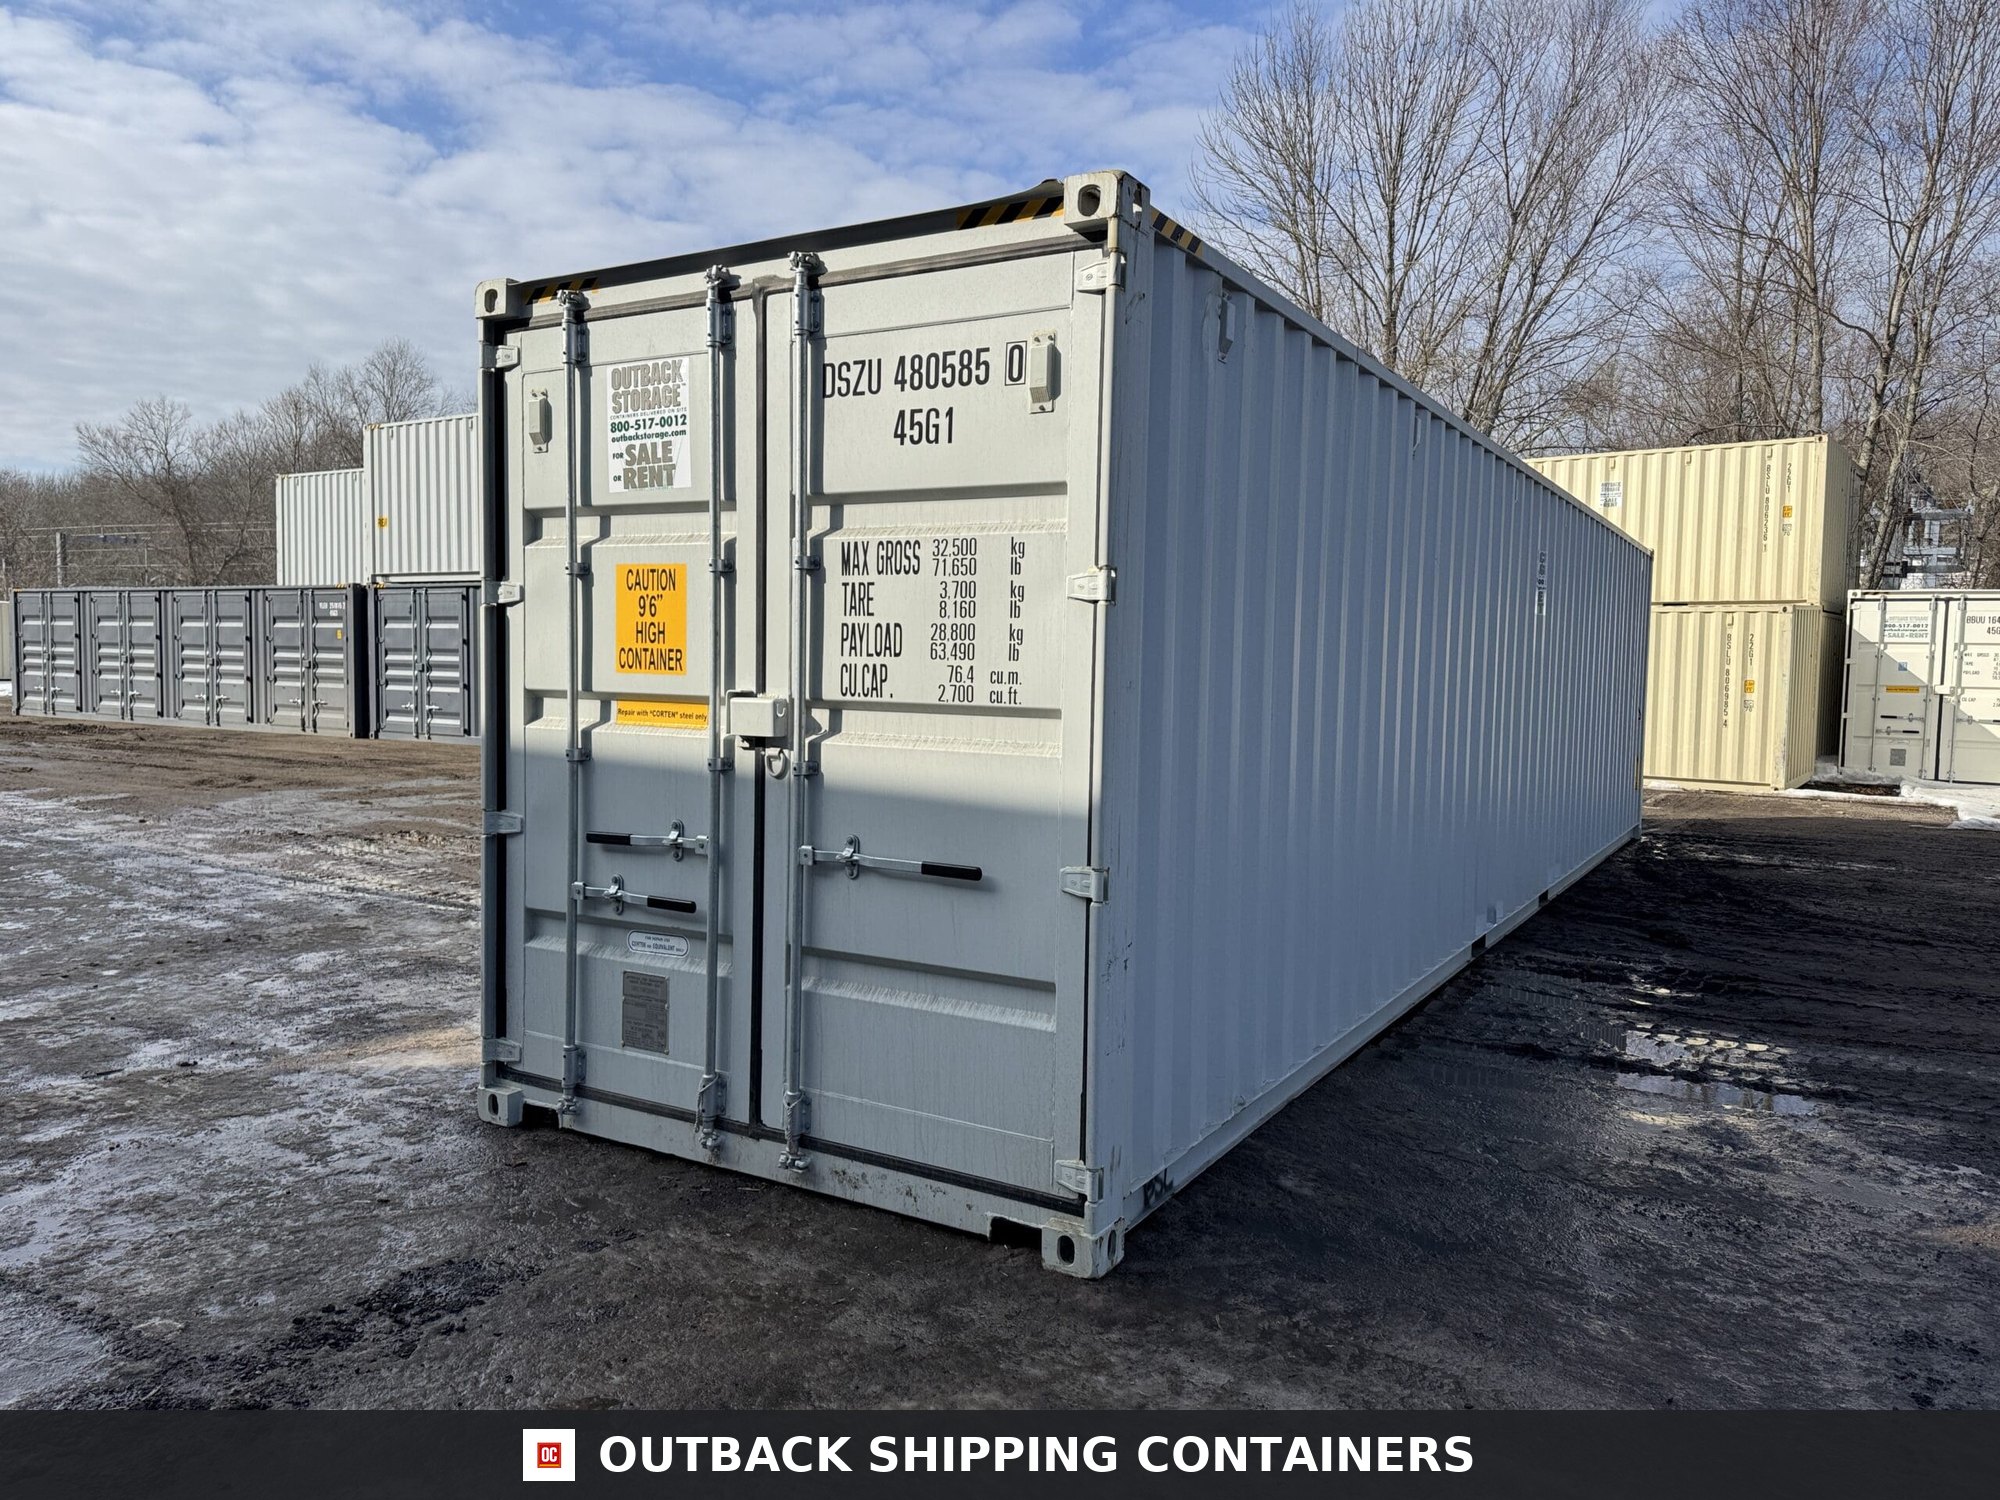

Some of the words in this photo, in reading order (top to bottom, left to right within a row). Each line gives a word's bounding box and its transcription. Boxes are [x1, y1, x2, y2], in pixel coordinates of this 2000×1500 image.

[611, 359, 684, 391] OUTBACK
[823, 358, 882, 398] DSZU
[894, 347, 990, 392] 480585
[1008, 344, 1024, 382] 0
[612, 384, 681, 414] STORAGE
[610, 414, 687, 433] 800-517-0012
[894, 407, 954, 445] 45G1
[611, 429, 687, 443] outbackstorage.com
[612, 452, 624, 460] FOR
[625, 440, 673, 466] SALE
[623, 464, 676, 490] RENT
[841, 540, 870, 576] MAX
[876, 539, 921, 575] GROSS
[932, 537, 977, 557] 32,500
[1010, 537, 1025, 559] kg
[932, 557, 977, 577] 71,650
[1010, 557, 1022, 575] lb
[626, 568, 676, 592] CAUTION
[842, 582, 875, 617] TARE
[939, 580, 976, 600] 3,700
[1010, 580, 1025, 602] kg
[939, 600, 976, 619] 8,160
[1009, 600, 1021, 618] lb
[635, 621, 666, 645] HIGH
[841, 622, 903, 658] PAYLOAD
[930, 623, 976, 642] 28,800
[1009, 623, 1024, 645] kg
[619, 647, 683, 671] CONTAINER
[930, 642, 975, 661] 63,490
[1008, 643, 1019, 662] lb
[947, 664, 974, 683] 76.4
[990, 670, 1022, 685] cu.m.
[938, 684, 974, 703] 2,700
[989, 686, 1022, 705] cu.ft.
[617, 708, 636, 717] Repair
[679, 712, 694, 720] steel
[695, 714, 708, 722] only
